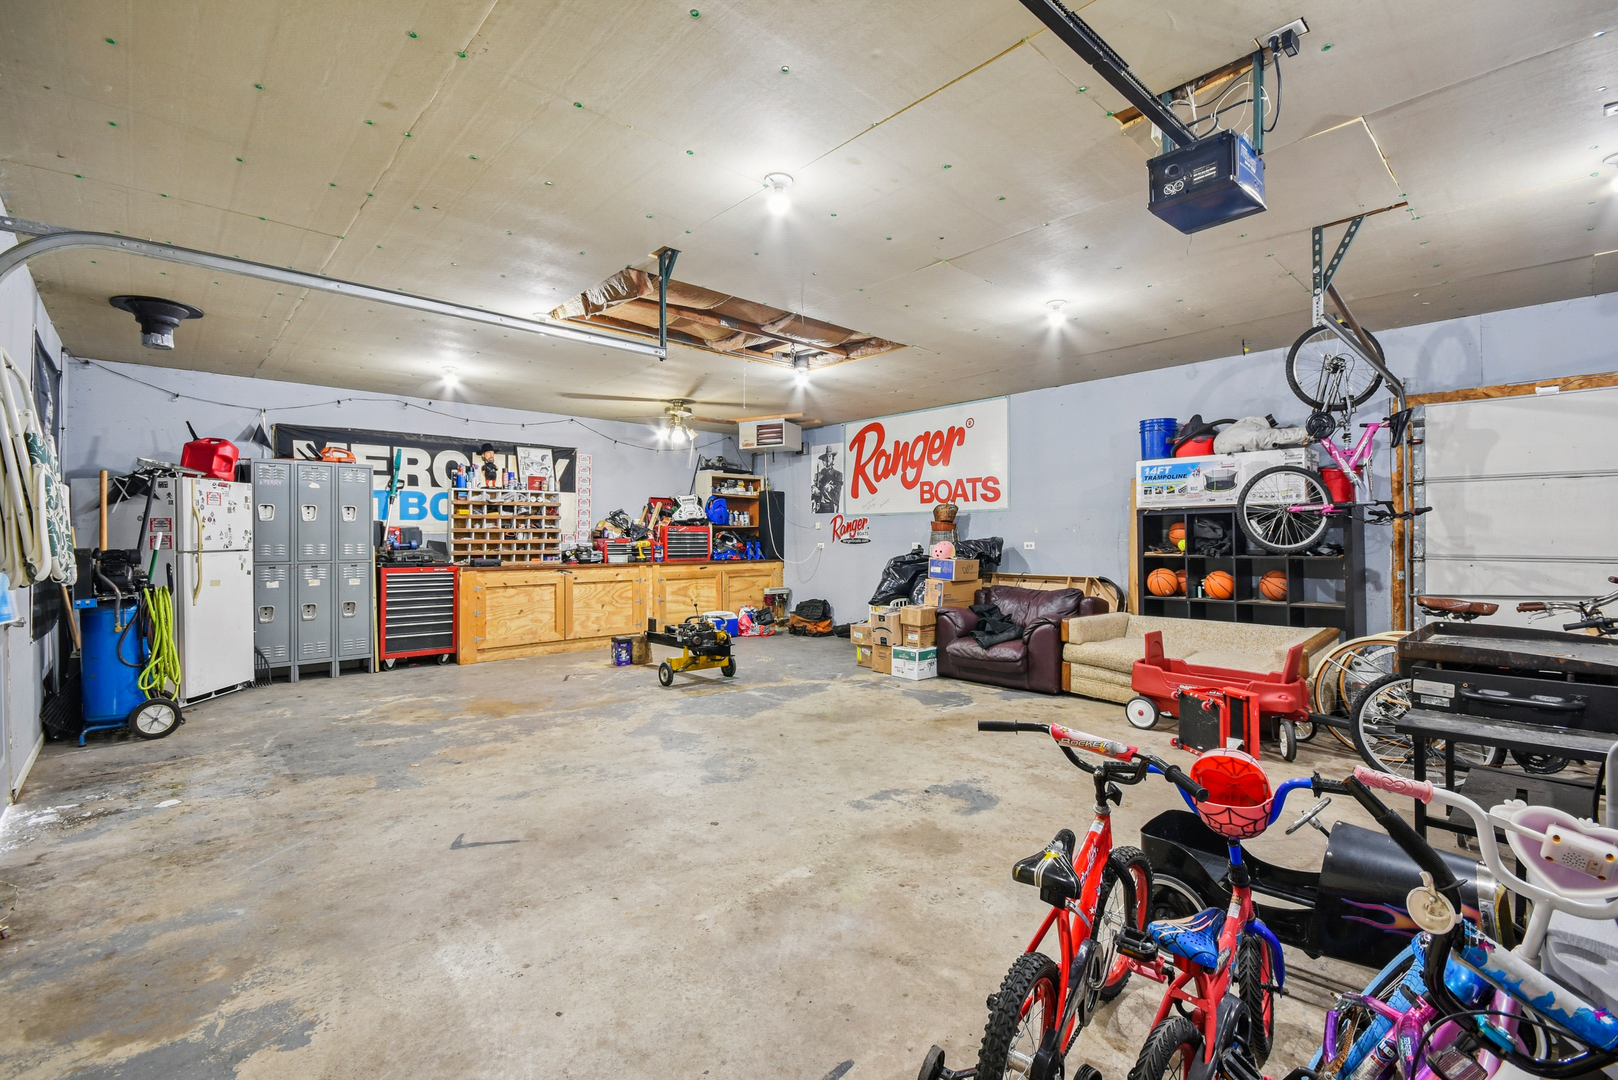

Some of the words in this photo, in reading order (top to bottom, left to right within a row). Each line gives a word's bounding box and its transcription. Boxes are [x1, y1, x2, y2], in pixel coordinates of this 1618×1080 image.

[1144, 466, 1172, 475] 14FT
[920, 476, 1001, 504] BOATS
[830, 514, 868, 543] Ranger
[1060, 737, 1108, 748] ROCKET
